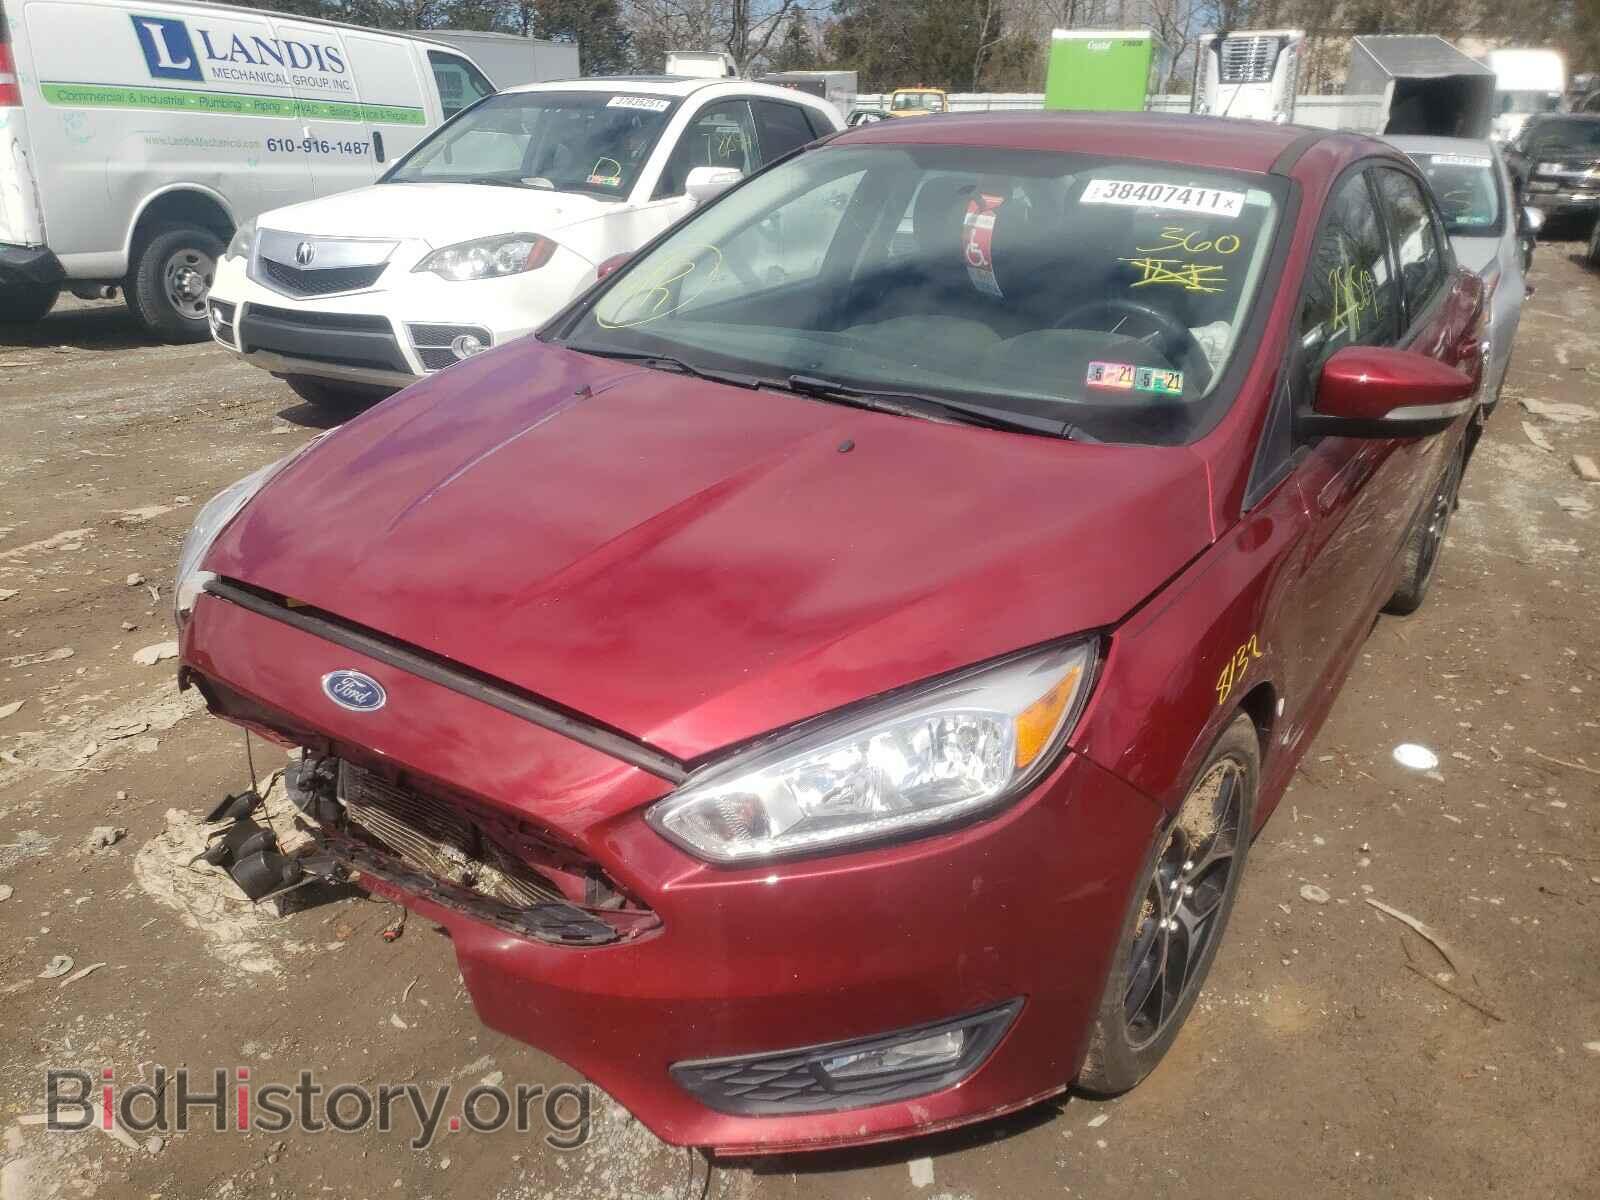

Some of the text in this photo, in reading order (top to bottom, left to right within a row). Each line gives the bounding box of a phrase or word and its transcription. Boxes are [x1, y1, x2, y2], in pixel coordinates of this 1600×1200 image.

[142, 22, 191, 70] L
[197, 29, 345, 74] LANDIS
[211, 67, 289, 86] MECHANICAL
[57, 89, 125, 103] Commercial
[128, 92, 137, 103] &
[140, 94, 185, 106] Industrial
[267, 137, 370, 155] 610-916-1487
[1102, 182, 1222, 208] 38407411
[1135, 224, 1241, 254] 360
[1096, 366, 1132, 382] 5 21
[1143, 373, 1180, 389] 5 21
[334, 677, 373, 704] Ford
